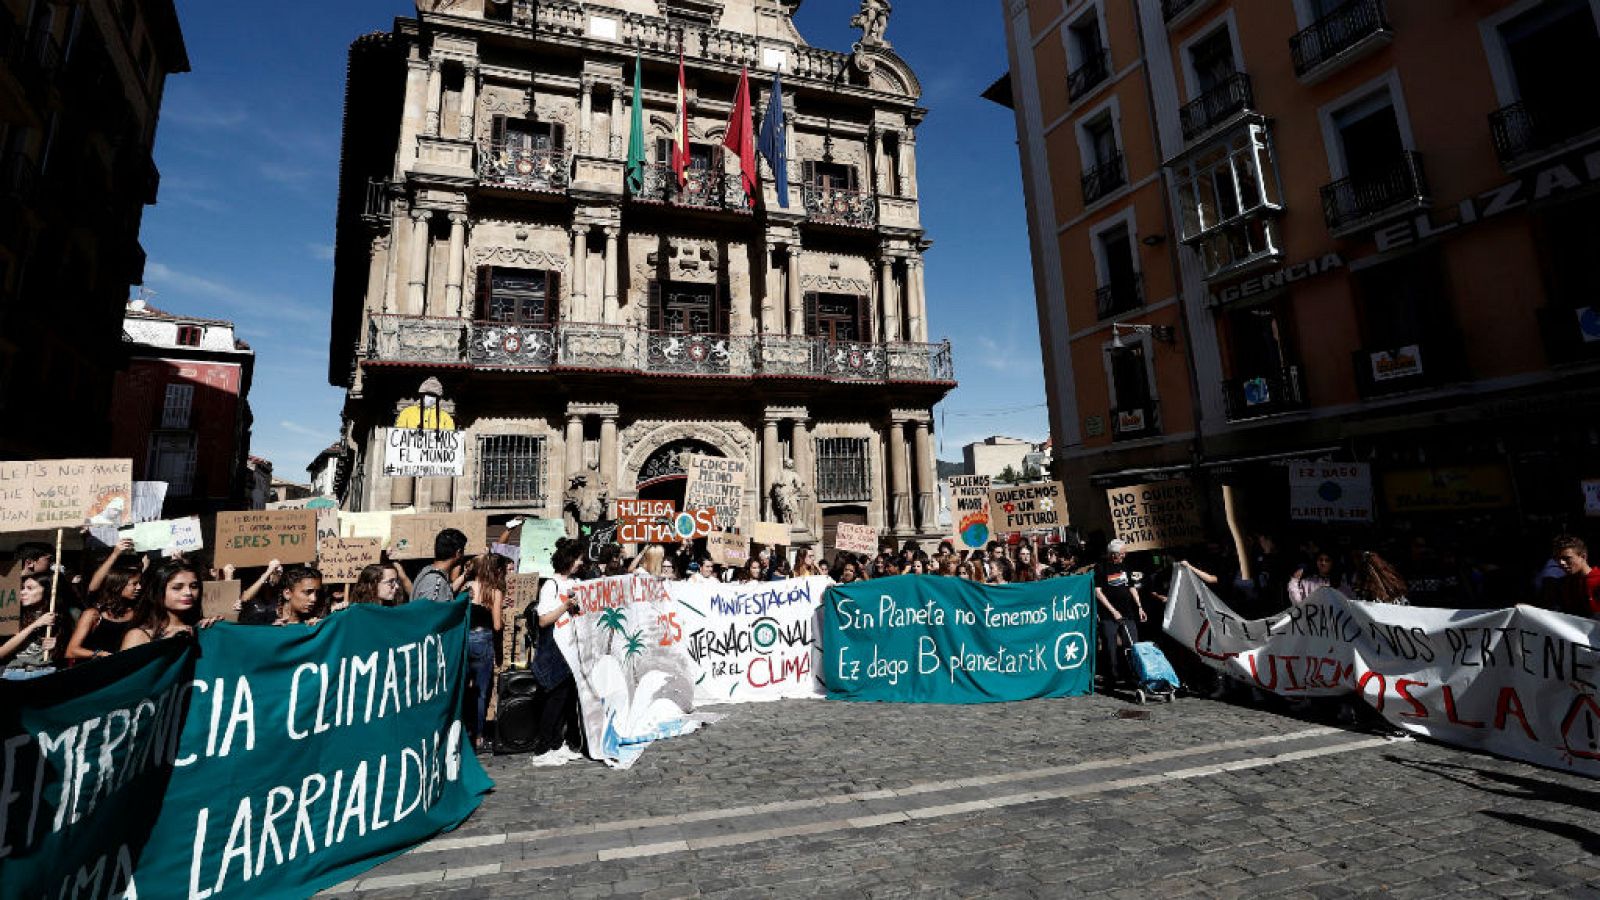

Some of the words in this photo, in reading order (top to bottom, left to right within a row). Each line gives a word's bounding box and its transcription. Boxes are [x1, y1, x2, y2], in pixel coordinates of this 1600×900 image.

[1375, 149, 1600, 253] ELIZA
[1205, 253, 1345, 307] AGENCIA
[391, 428, 460, 450] CAMBIEMOS
[400, 448, 413, 463] EL
[420, 449, 456, 463] MUNDO
[59, 465, 86, 476] NOT
[995, 485, 1059, 503] QUEREMOS
[1113, 493, 1135, 506] NO
[619, 501, 675, 517] HUELGA
[1018, 501, 1035, 511] UN
[1114, 505, 1137, 518] QUE
[1007, 511, 1058, 527] FUTURO!
[621, 523, 675, 541] CLIMA
[837, 598, 875, 631] Sin
[879, 594, 945, 628] Planeta
[955, 607, 977, 627] no
[984, 603, 1049, 629] tenemos
[1369, 623, 1435, 663] NOS
[729, 662, 744, 674] EL
[838, 645, 861, 681] Ez
[866, 643, 909, 685] dago
[918, 635, 941, 675] B
[286, 633, 448, 740] CLIMATICA
